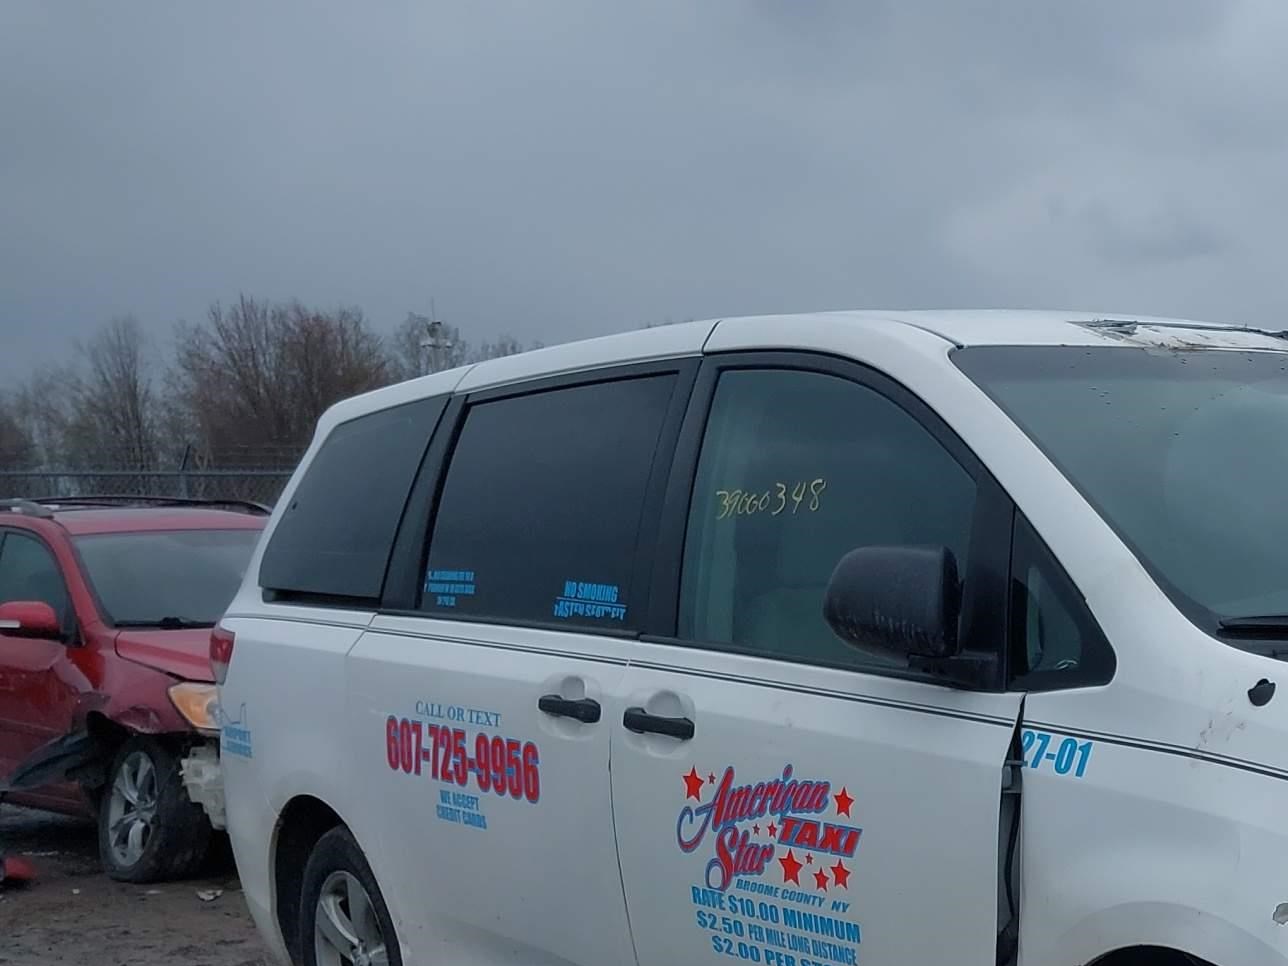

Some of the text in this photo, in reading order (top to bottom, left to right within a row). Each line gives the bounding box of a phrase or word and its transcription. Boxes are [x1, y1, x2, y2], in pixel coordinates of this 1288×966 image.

[564, 581, 618, 602] NO SMOKING
[415, 700, 501, 728] CALL OR TEXT
[385, 714, 541, 804] 607-725-9956
[676, 764, 831, 853] American
[705, 824, 776, 892] Star
[779, 815, 863, 858] TAXI
[692, 886, 862, 944] RATE $10.00 MINIMUM
[735, 877, 850, 914] BROOME COUNTY NY
[696, 910, 858, 966] $2.50 PER MILE LONG DISTANCE
[711, 935, 761, 963] $2.00
